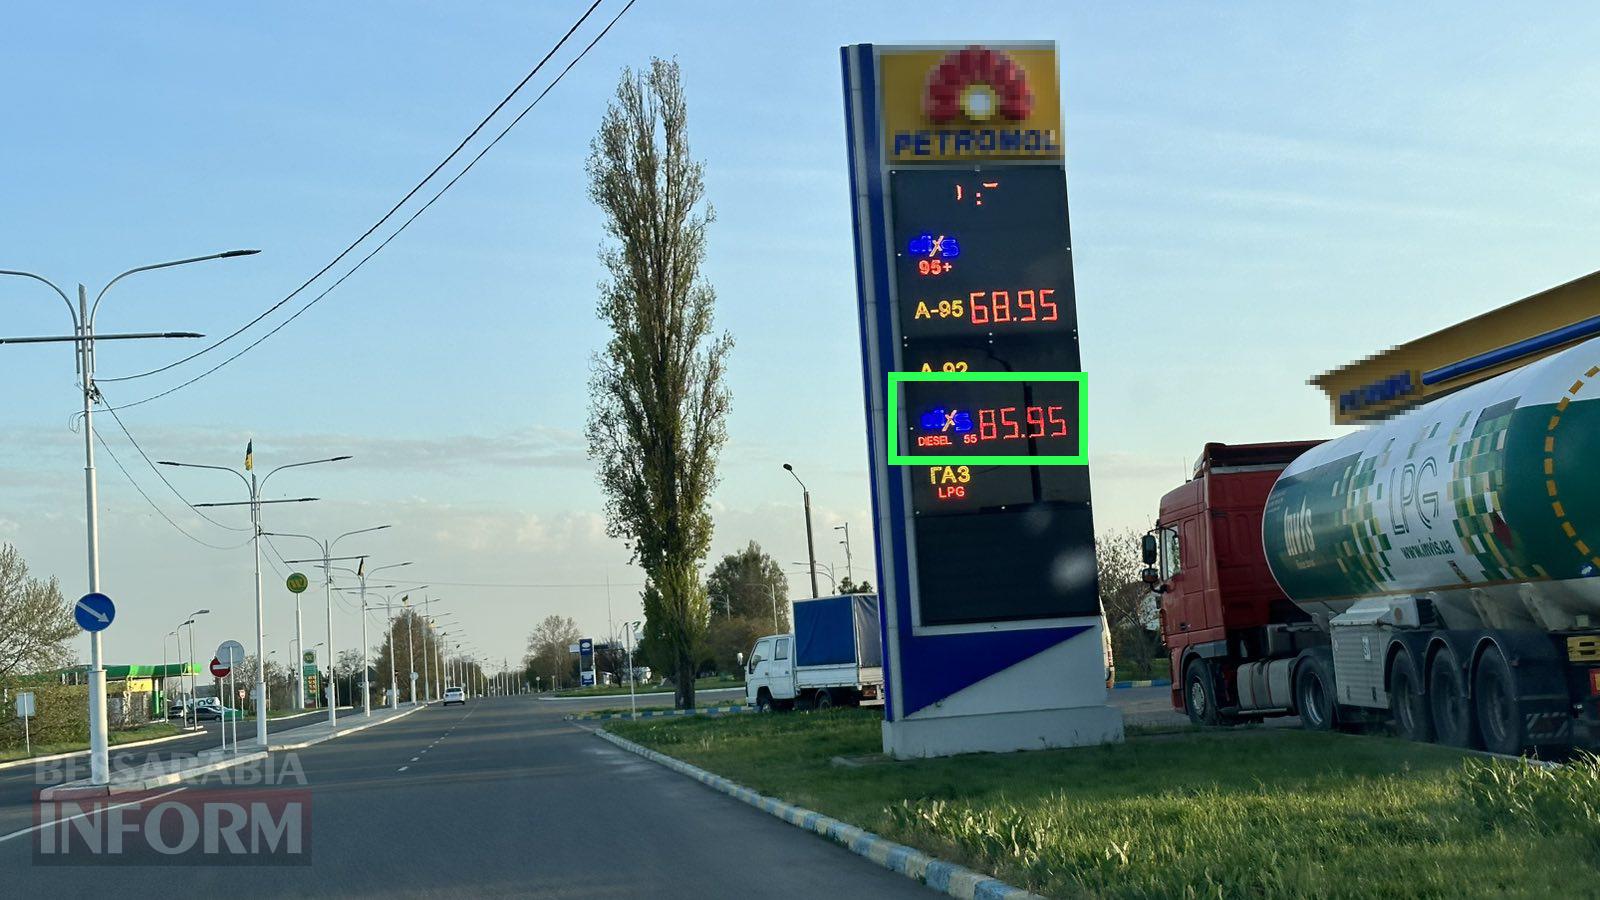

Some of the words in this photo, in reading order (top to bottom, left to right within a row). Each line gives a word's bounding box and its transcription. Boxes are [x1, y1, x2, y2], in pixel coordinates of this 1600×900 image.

[918, 259, 953, 275] 95+
[969, 289, 1059, 325] 68.95
[978, 406, 1068, 441] 85.95
[917, 435, 953, 447] DIESEL
[963, 433, 978, 444] 55
[930, 465, 972, 485] ГАЗ
[938, 486, 965, 498] LPG
[1389, 456, 1439, 535] LPG
[1400, 536, 1456, 559] www.invis.ua
